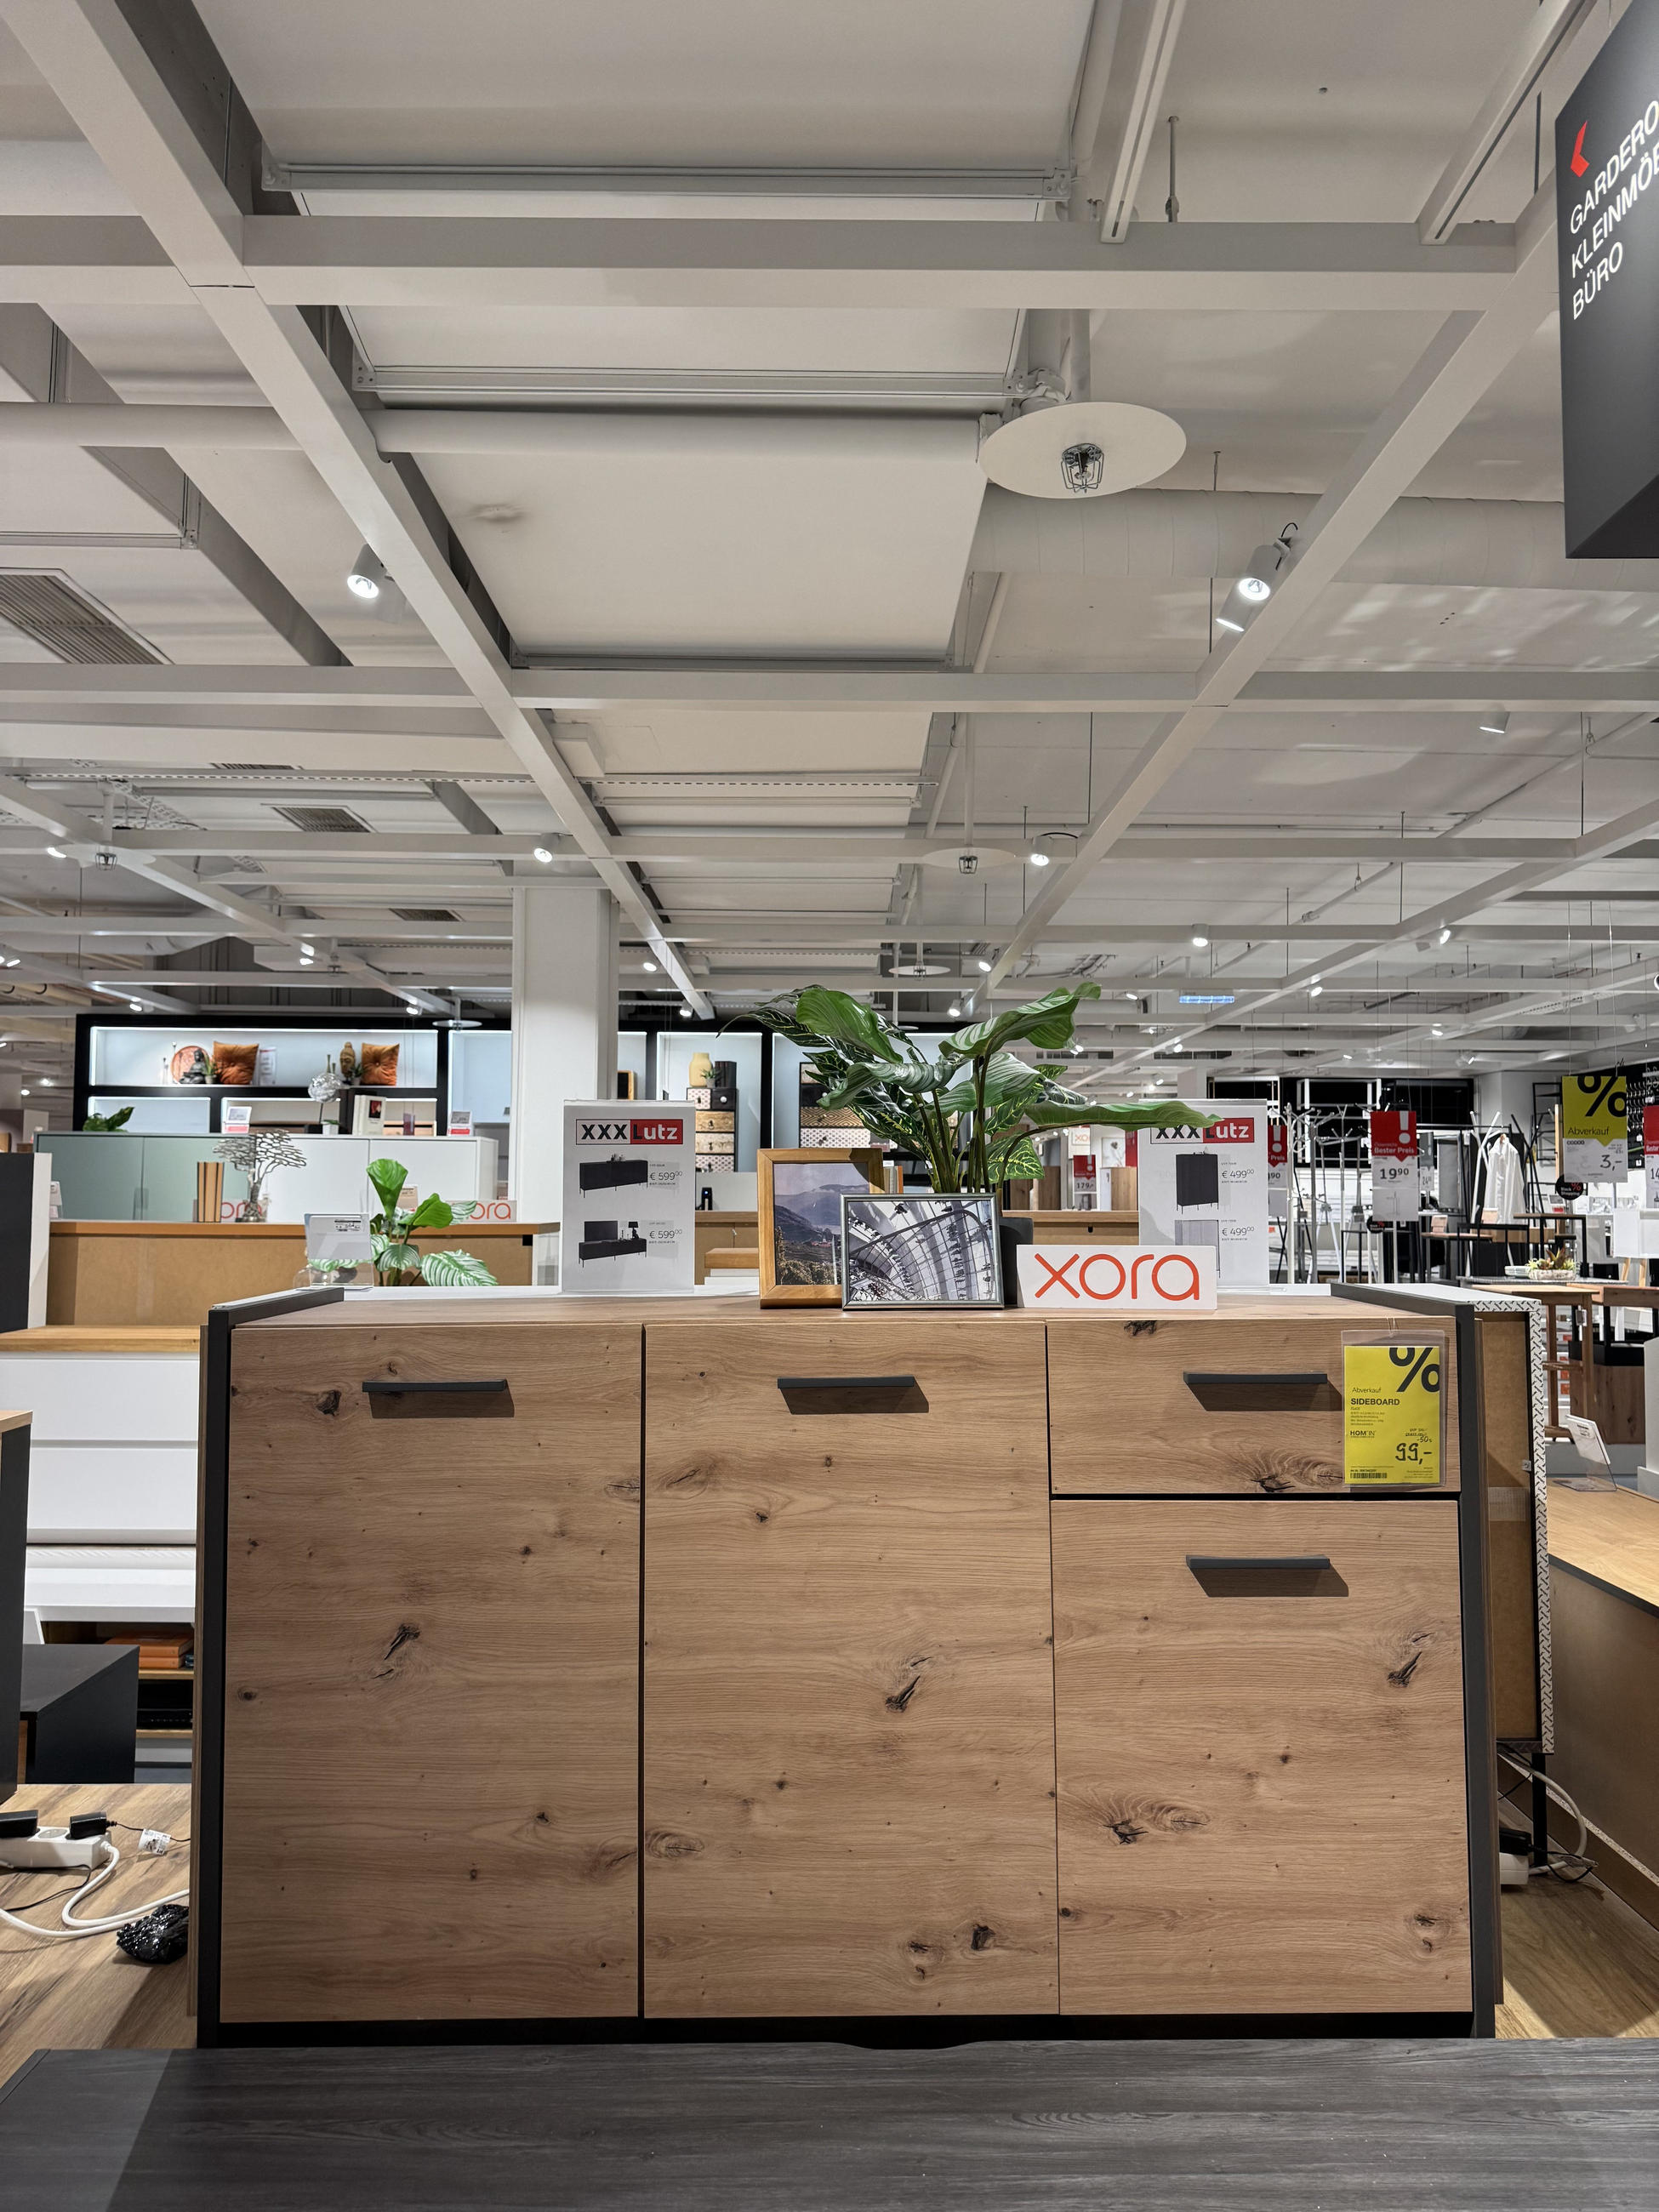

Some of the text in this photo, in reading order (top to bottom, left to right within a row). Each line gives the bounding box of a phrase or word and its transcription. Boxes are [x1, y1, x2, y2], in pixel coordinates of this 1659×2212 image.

[1573, 242, 1622, 320] BÜRO
[1568, 1126, 1610, 1136] Abverkauf
[1600, 1154, 1622, 1172] 3,-
[649, 1172, 656, 1181] €
[1222, 1171, 1228, 1179] €
[649, 1230, 656, 1239] €
[1222, 1228, 1228, 1236] €
[1034, 1252, 1200, 1302] xora
[1395, 1443, 1433, 1465] 99,-
